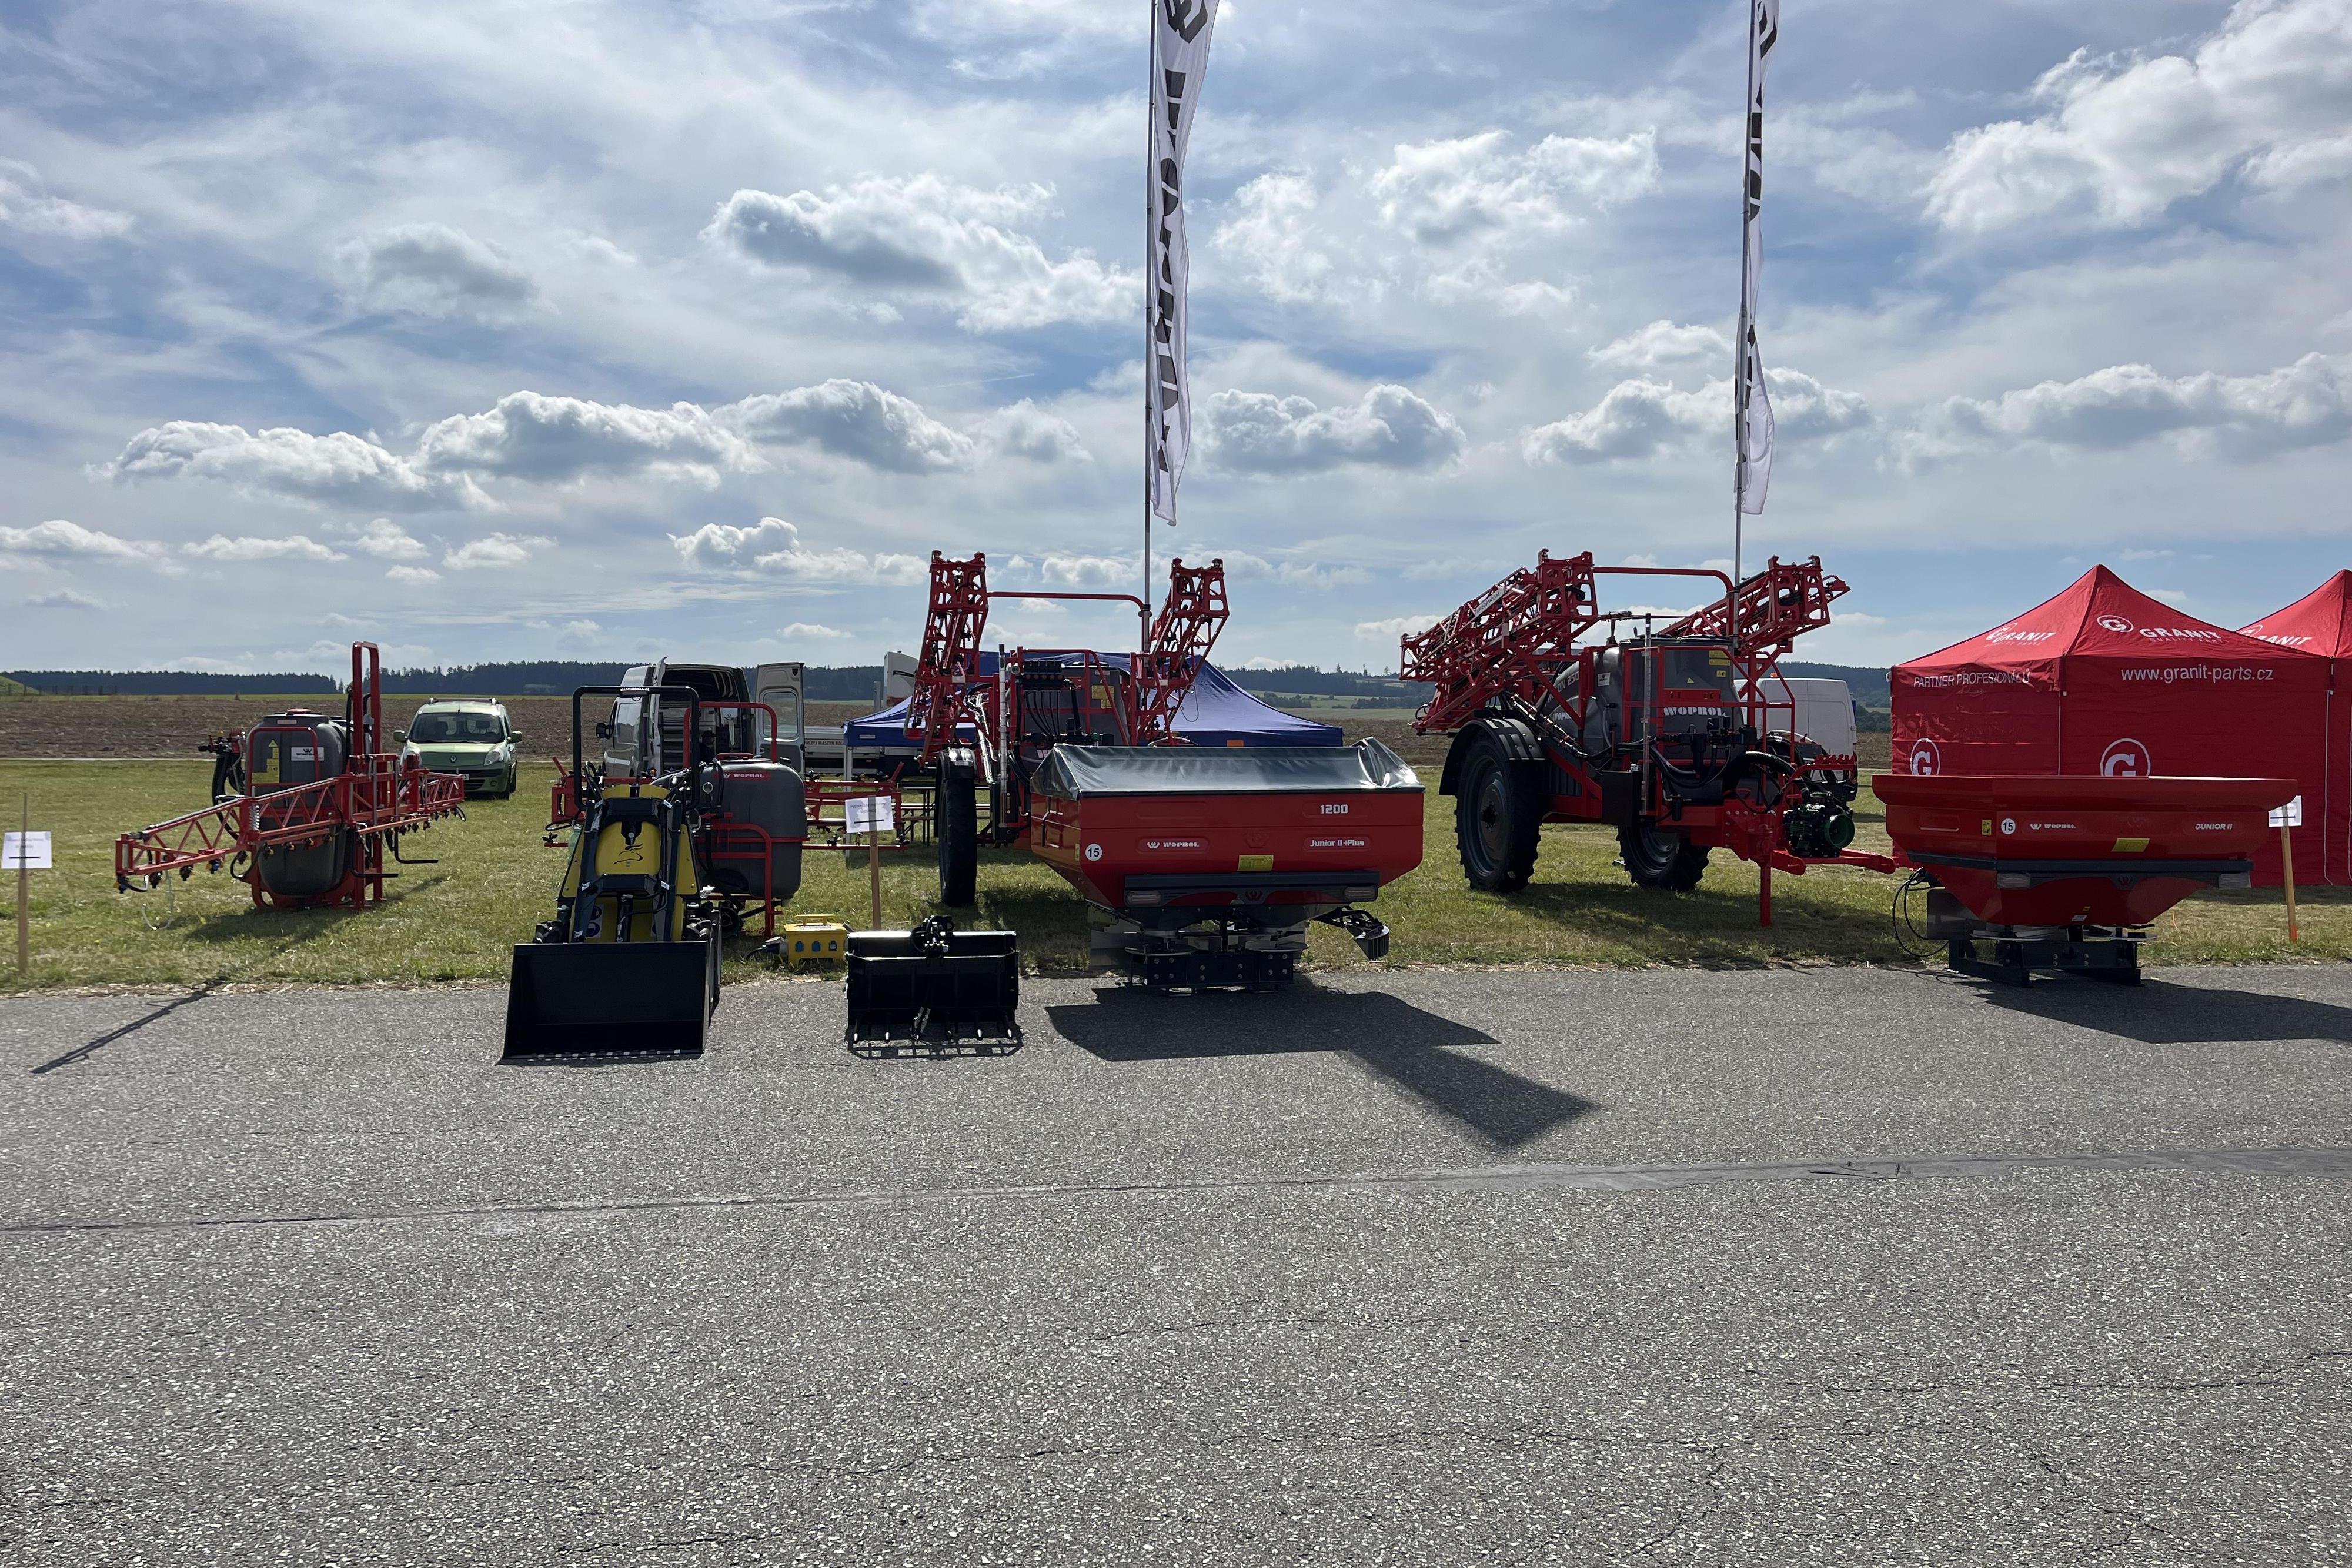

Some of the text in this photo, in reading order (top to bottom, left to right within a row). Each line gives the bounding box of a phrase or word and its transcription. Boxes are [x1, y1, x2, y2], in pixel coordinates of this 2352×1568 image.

[1992, 631, 2057, 643] GRANIT
[2139, 628, 2221, 640] GRANIT
[2257, 635, 2313, 645] RANIT
[1914, 668, 2030, 688] PARTNER PROFESIONÁLŮ
[2121, 664, 2274, 684] www.granit-parts.cz
[1663, 707, 1726, 716] WOPROL
[1321, 804, 1348, 814] 1200
[2003, 821, 2013, 831] 15
[1088, 847, 1100, 857] 15
